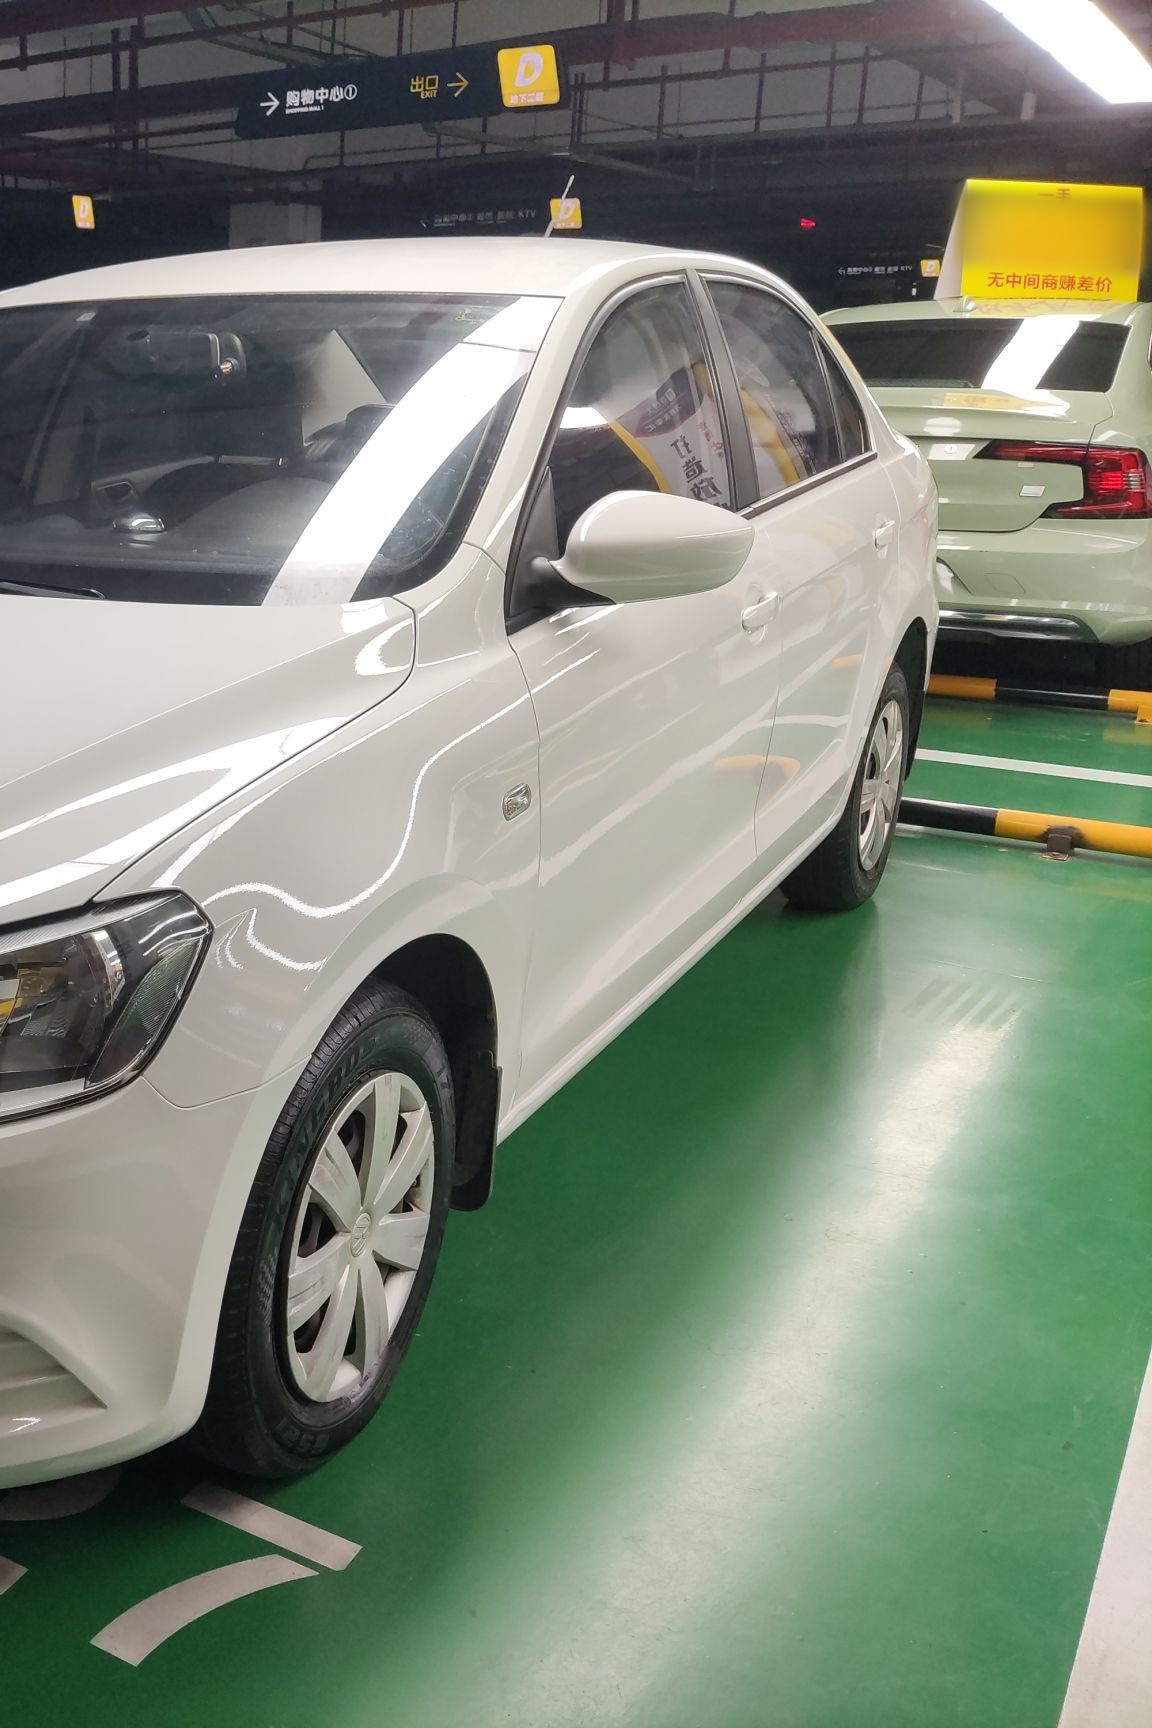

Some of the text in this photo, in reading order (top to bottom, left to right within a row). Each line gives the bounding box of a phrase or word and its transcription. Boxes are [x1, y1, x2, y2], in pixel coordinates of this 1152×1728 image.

[514, 53, 544, 87] D
[410, 75, 439, 92] 出口
[420, 90, 438, 99] EXIT
[518, 209, 536, 218] KTV
[559, 201, 575, 219] D
[987, 272, 1113, 293] 无中间商赚差价
